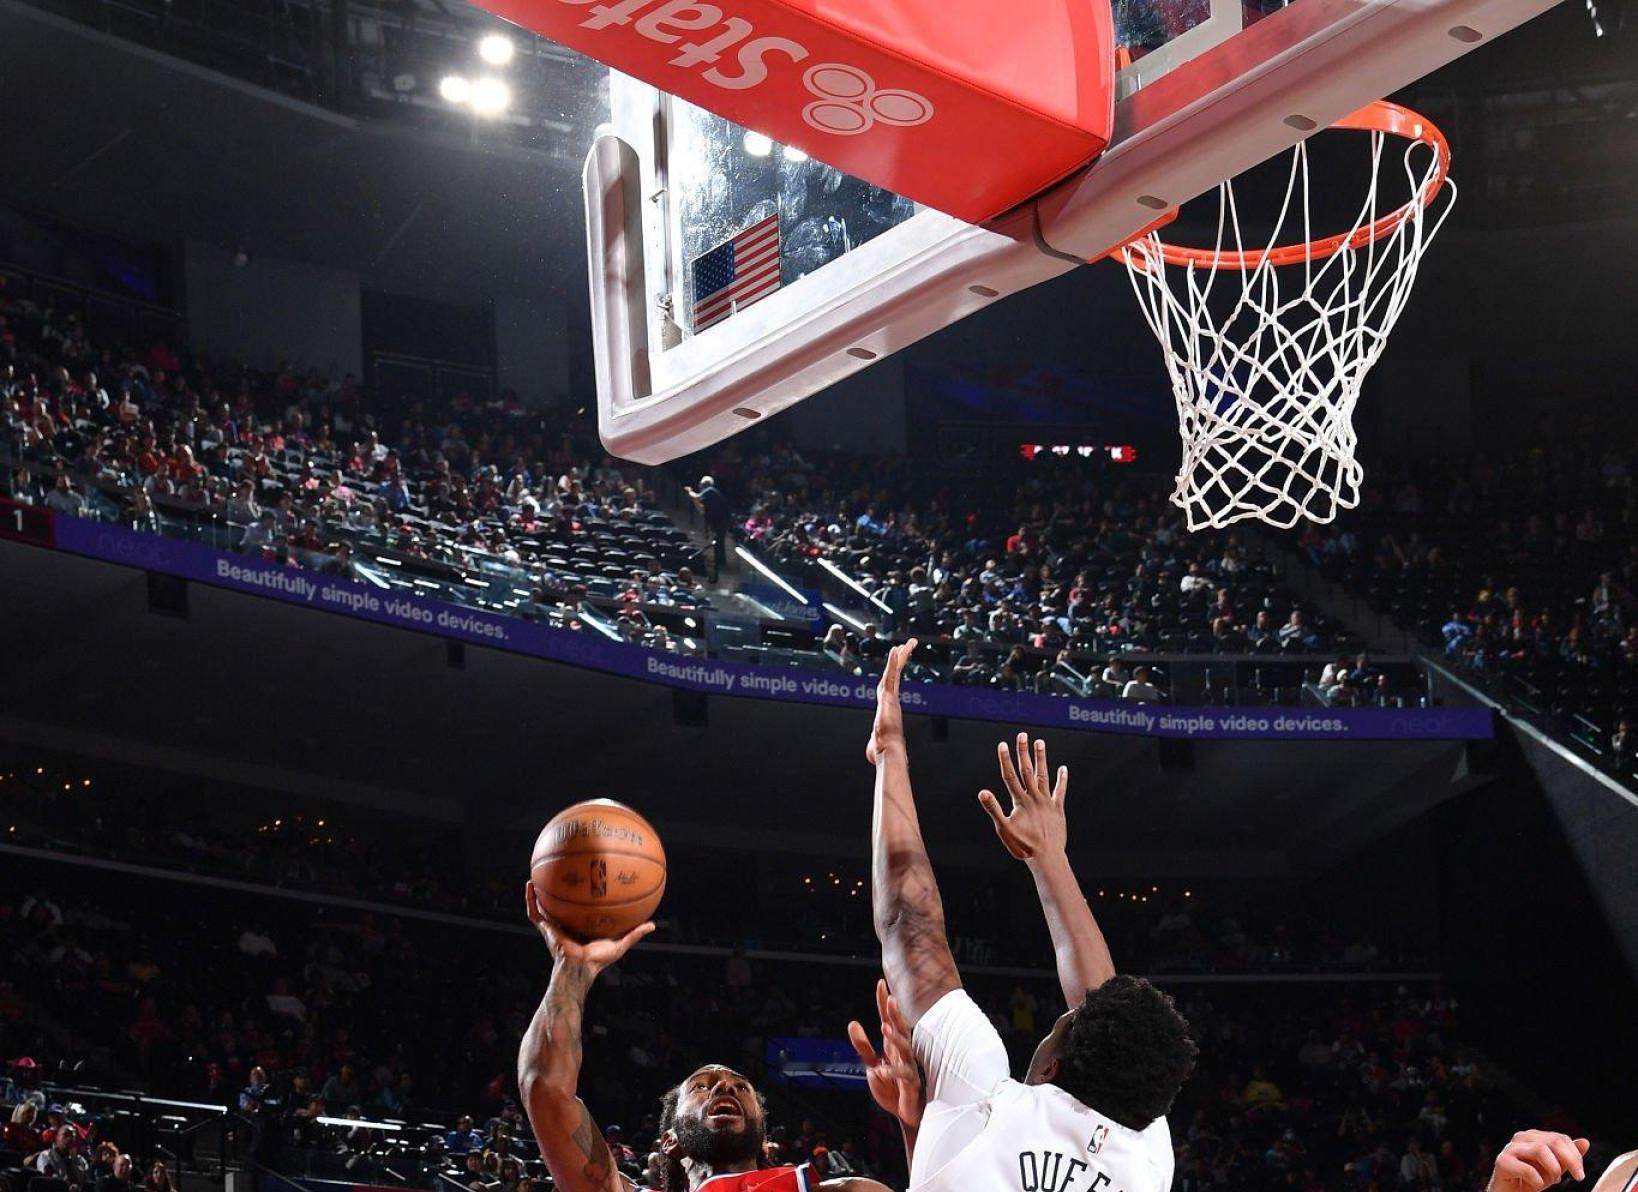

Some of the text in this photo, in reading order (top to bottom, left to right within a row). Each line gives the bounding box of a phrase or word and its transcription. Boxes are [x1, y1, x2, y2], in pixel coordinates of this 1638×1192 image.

[556, 0, 810, 90] Stat
[216, 558, 510, 641] Beautifully simple video devices.
[647, 656, 929, 706] Beautifully simple video dees.
[1068, 704, 1350, 735] Beautifully simple video devices.
